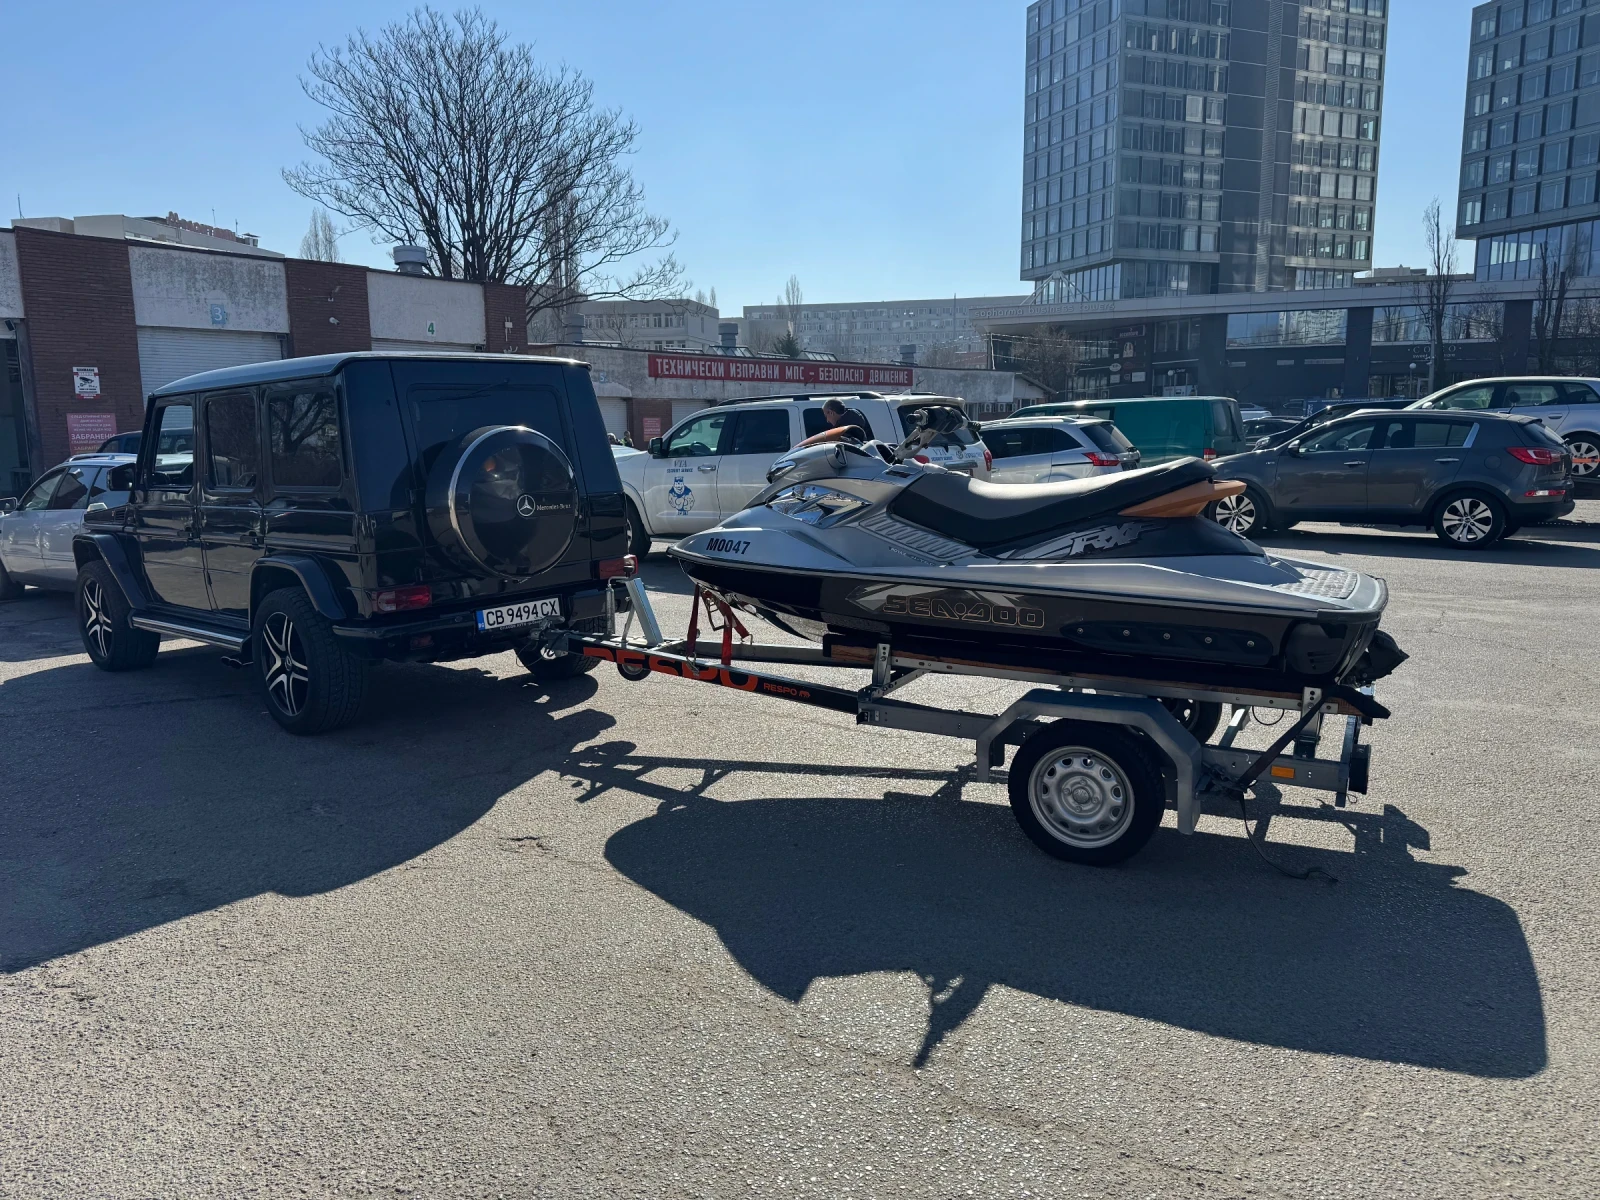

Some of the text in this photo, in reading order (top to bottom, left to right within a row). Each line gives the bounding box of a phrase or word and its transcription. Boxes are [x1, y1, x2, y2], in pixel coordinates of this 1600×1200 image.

[214, 307, 222, 321] 3
[1028, 305, 1073, 315] business
[1080, 302, 1115, 311] towers
[428, 323, 435, 335] 4
[655, 358, 724, 377] ТЕХНИЧЕСКИ
[730, 362, 780, 380] ИЗПРАВНИ
[785, 365, 805, 380] МПС
[819, 367, 864, 383] БЕЗОПАСНО
[868, 369, 908, 384] ДВИЖЕНИЕ
[486, 609, 505, 627] CB
[506, 603, 539, 623] 9494
[540, 600, 558, 617] CX
[763, 682, 798, 697] RESPO
